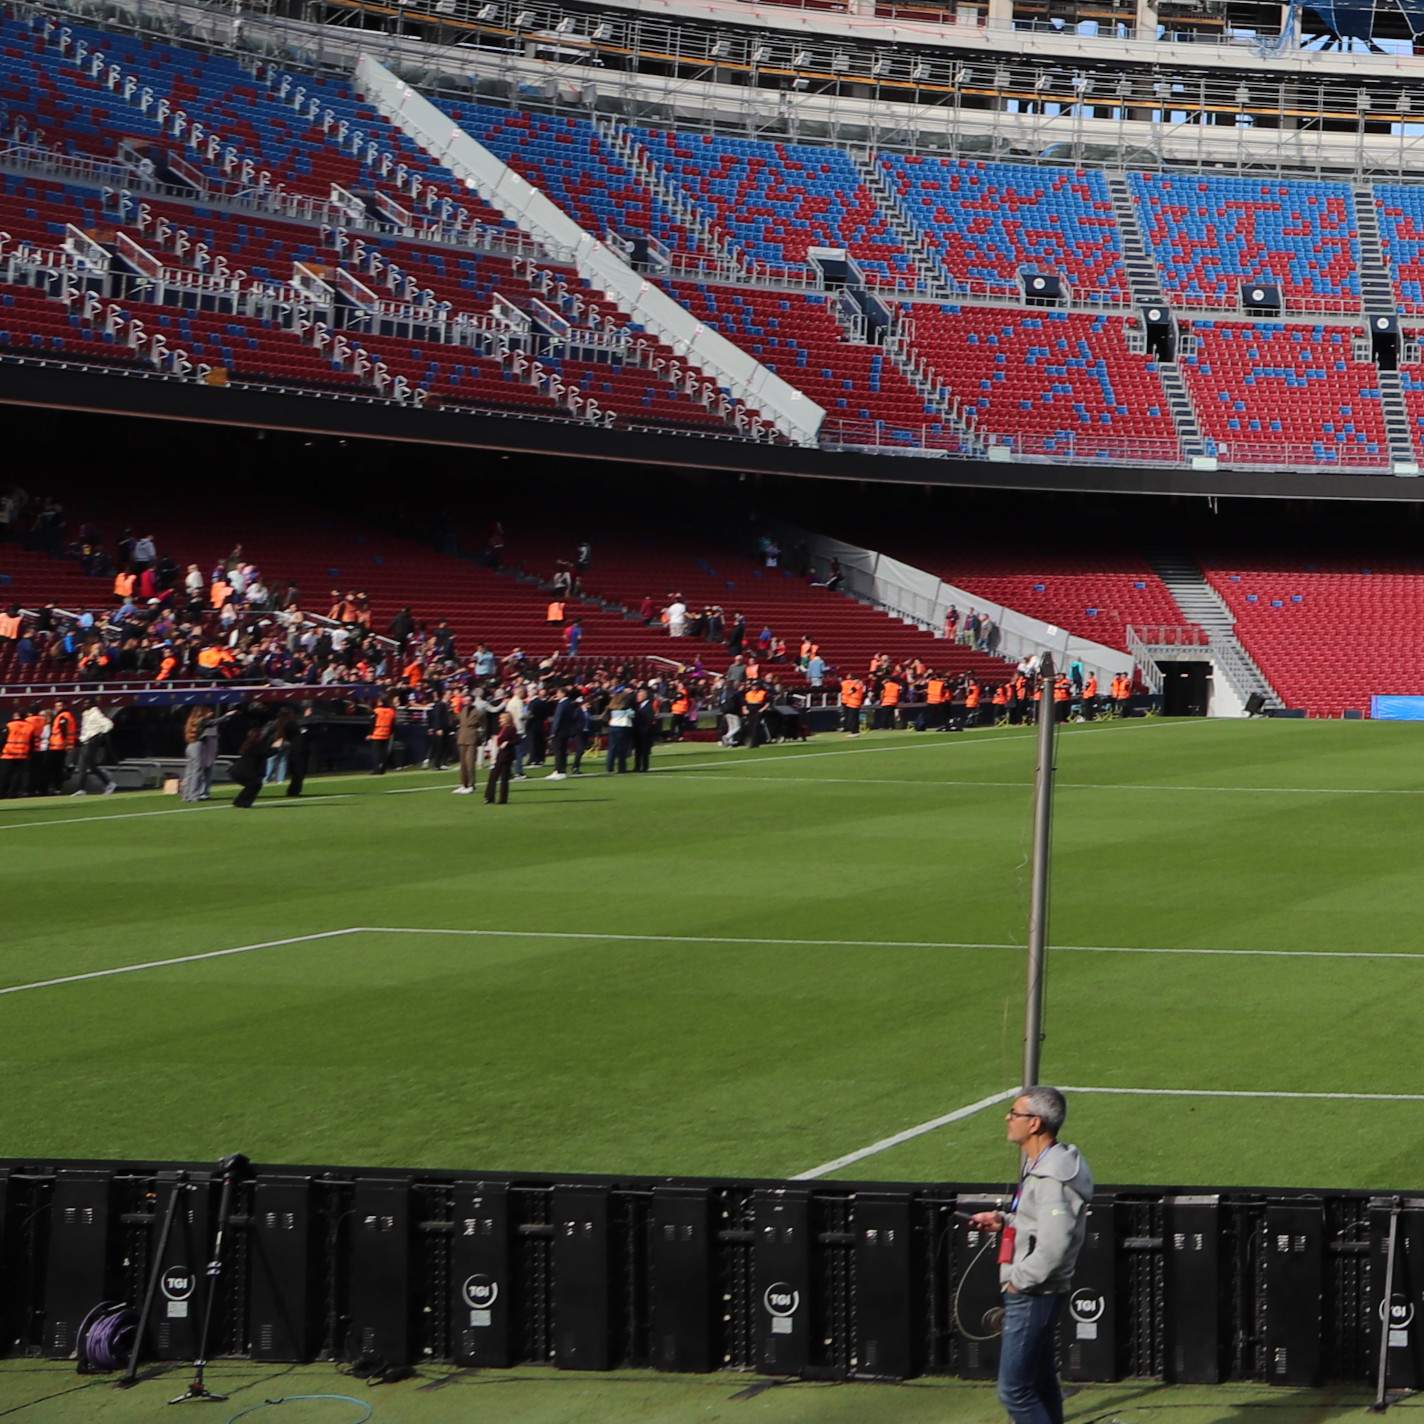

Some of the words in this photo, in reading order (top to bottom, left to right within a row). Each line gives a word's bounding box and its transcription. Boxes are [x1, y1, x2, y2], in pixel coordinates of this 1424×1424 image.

[168, 1278, 187, 1288] TGI
[469, 1286, 489, 1297] TGI
[770, 1294, 791, 1305] TGI
[1076, 1300, 1096, 1311] TGI
